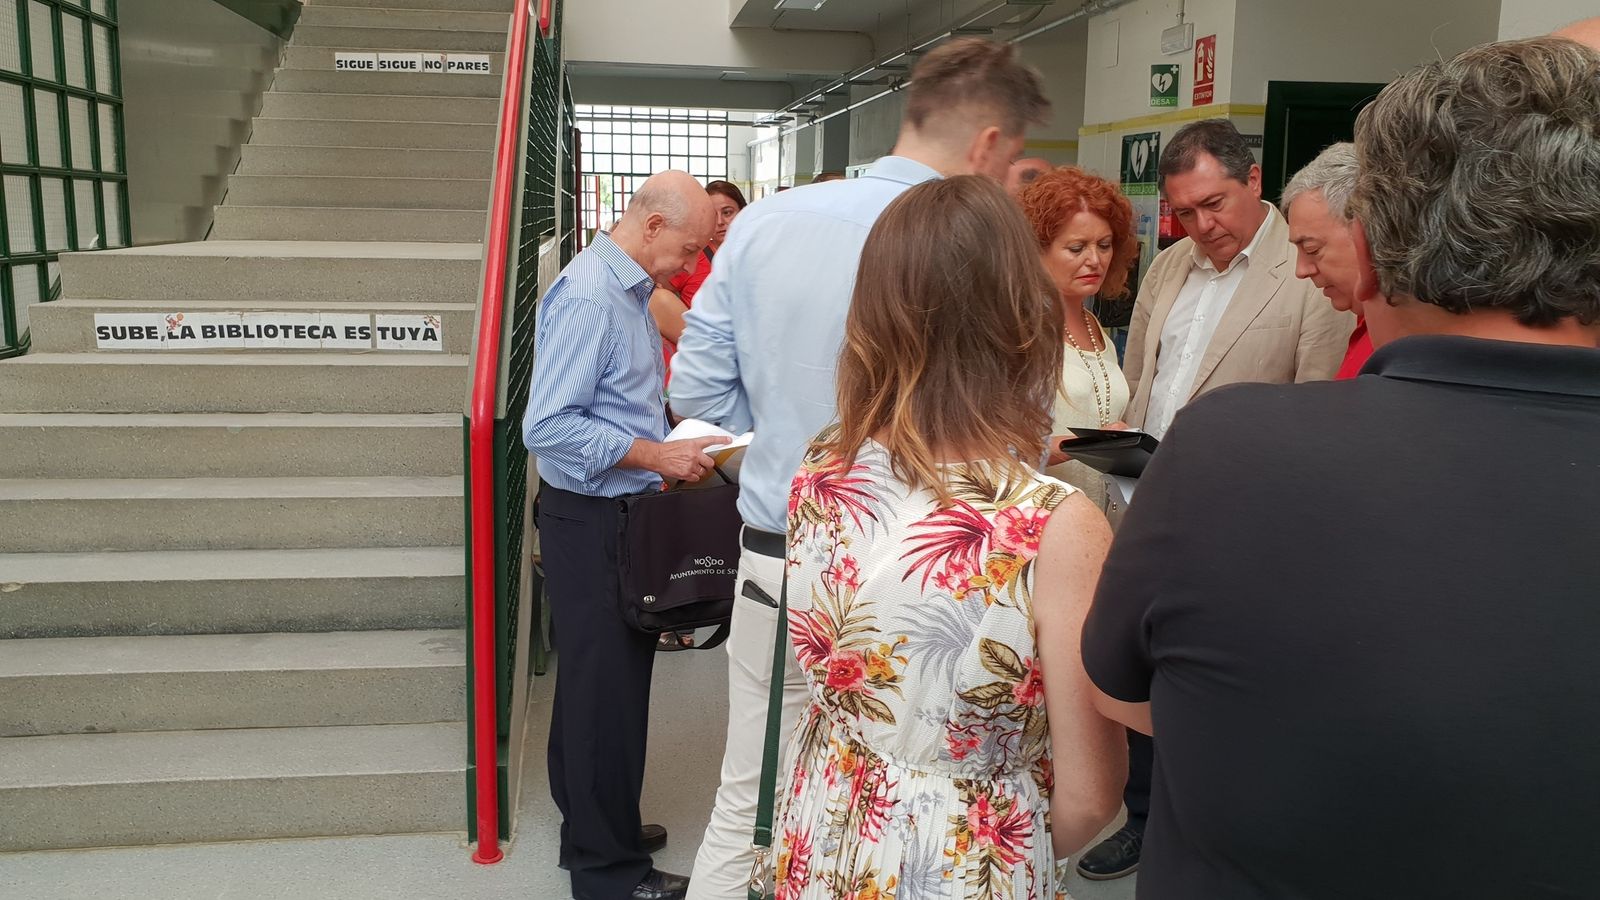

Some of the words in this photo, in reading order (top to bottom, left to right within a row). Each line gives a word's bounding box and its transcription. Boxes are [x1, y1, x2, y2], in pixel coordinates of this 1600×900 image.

[336, 60, 373, 69] SIGUE
[379, 60, 416, 70] SIGUE
[424, 60, 442, 70] NO
[447, 61, 489, 71] PARES
[1151, 98, 1170, 106] DESA
[167, 325, 196, 340] LA
[201, 324, 337, 339] BIBLIOTECA
[344, 325, 371, 340] ES
[377, 326, 438, 341] TUYA
